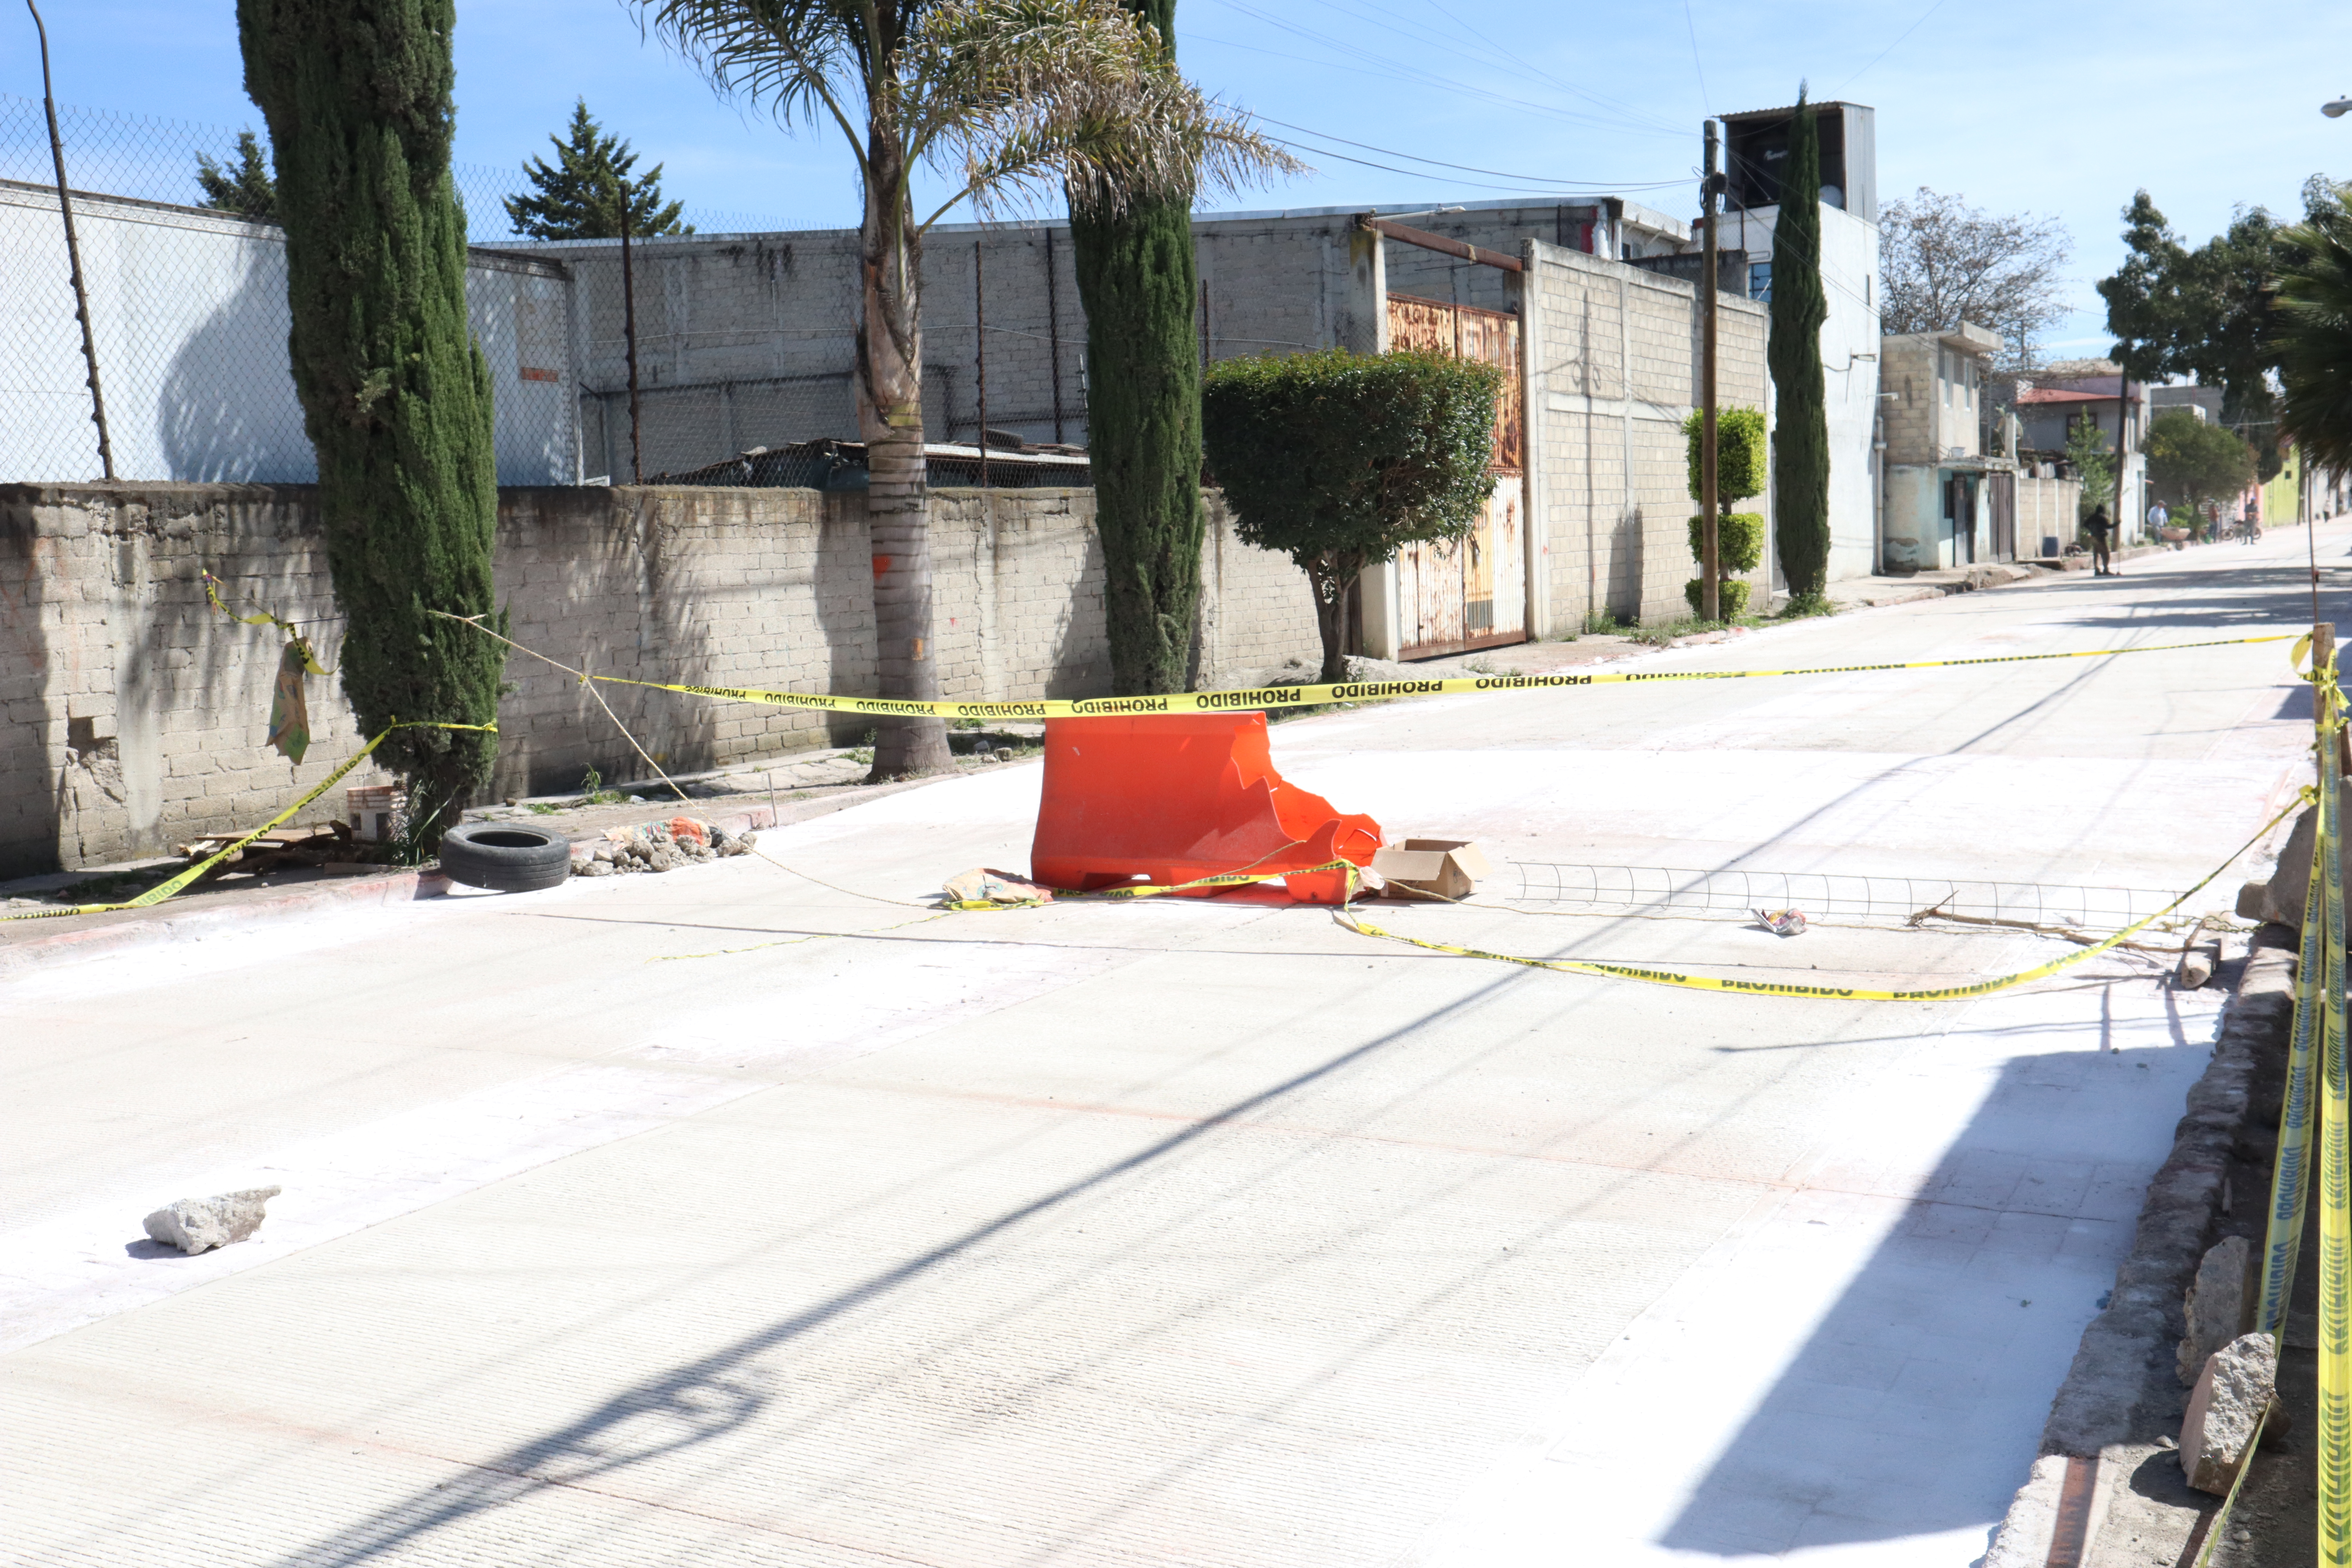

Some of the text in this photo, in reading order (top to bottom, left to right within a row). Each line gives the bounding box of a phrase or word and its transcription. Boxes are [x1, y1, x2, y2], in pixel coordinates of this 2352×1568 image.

[1333, 680, 1443, 699] PROHIBIDO
[1476, 675, 1592, 689] PROHIBIDO
[765, 693, 837, 708] PROHIBIDO
[1072, 698, 1168, 713] PROHIBIDO
[1197, 688, 1301, 708] PROHIBIDO
[856, 701, 936, 715] PROHIBIDO
[958, 704, 1047, 716] PROHIBIDO
